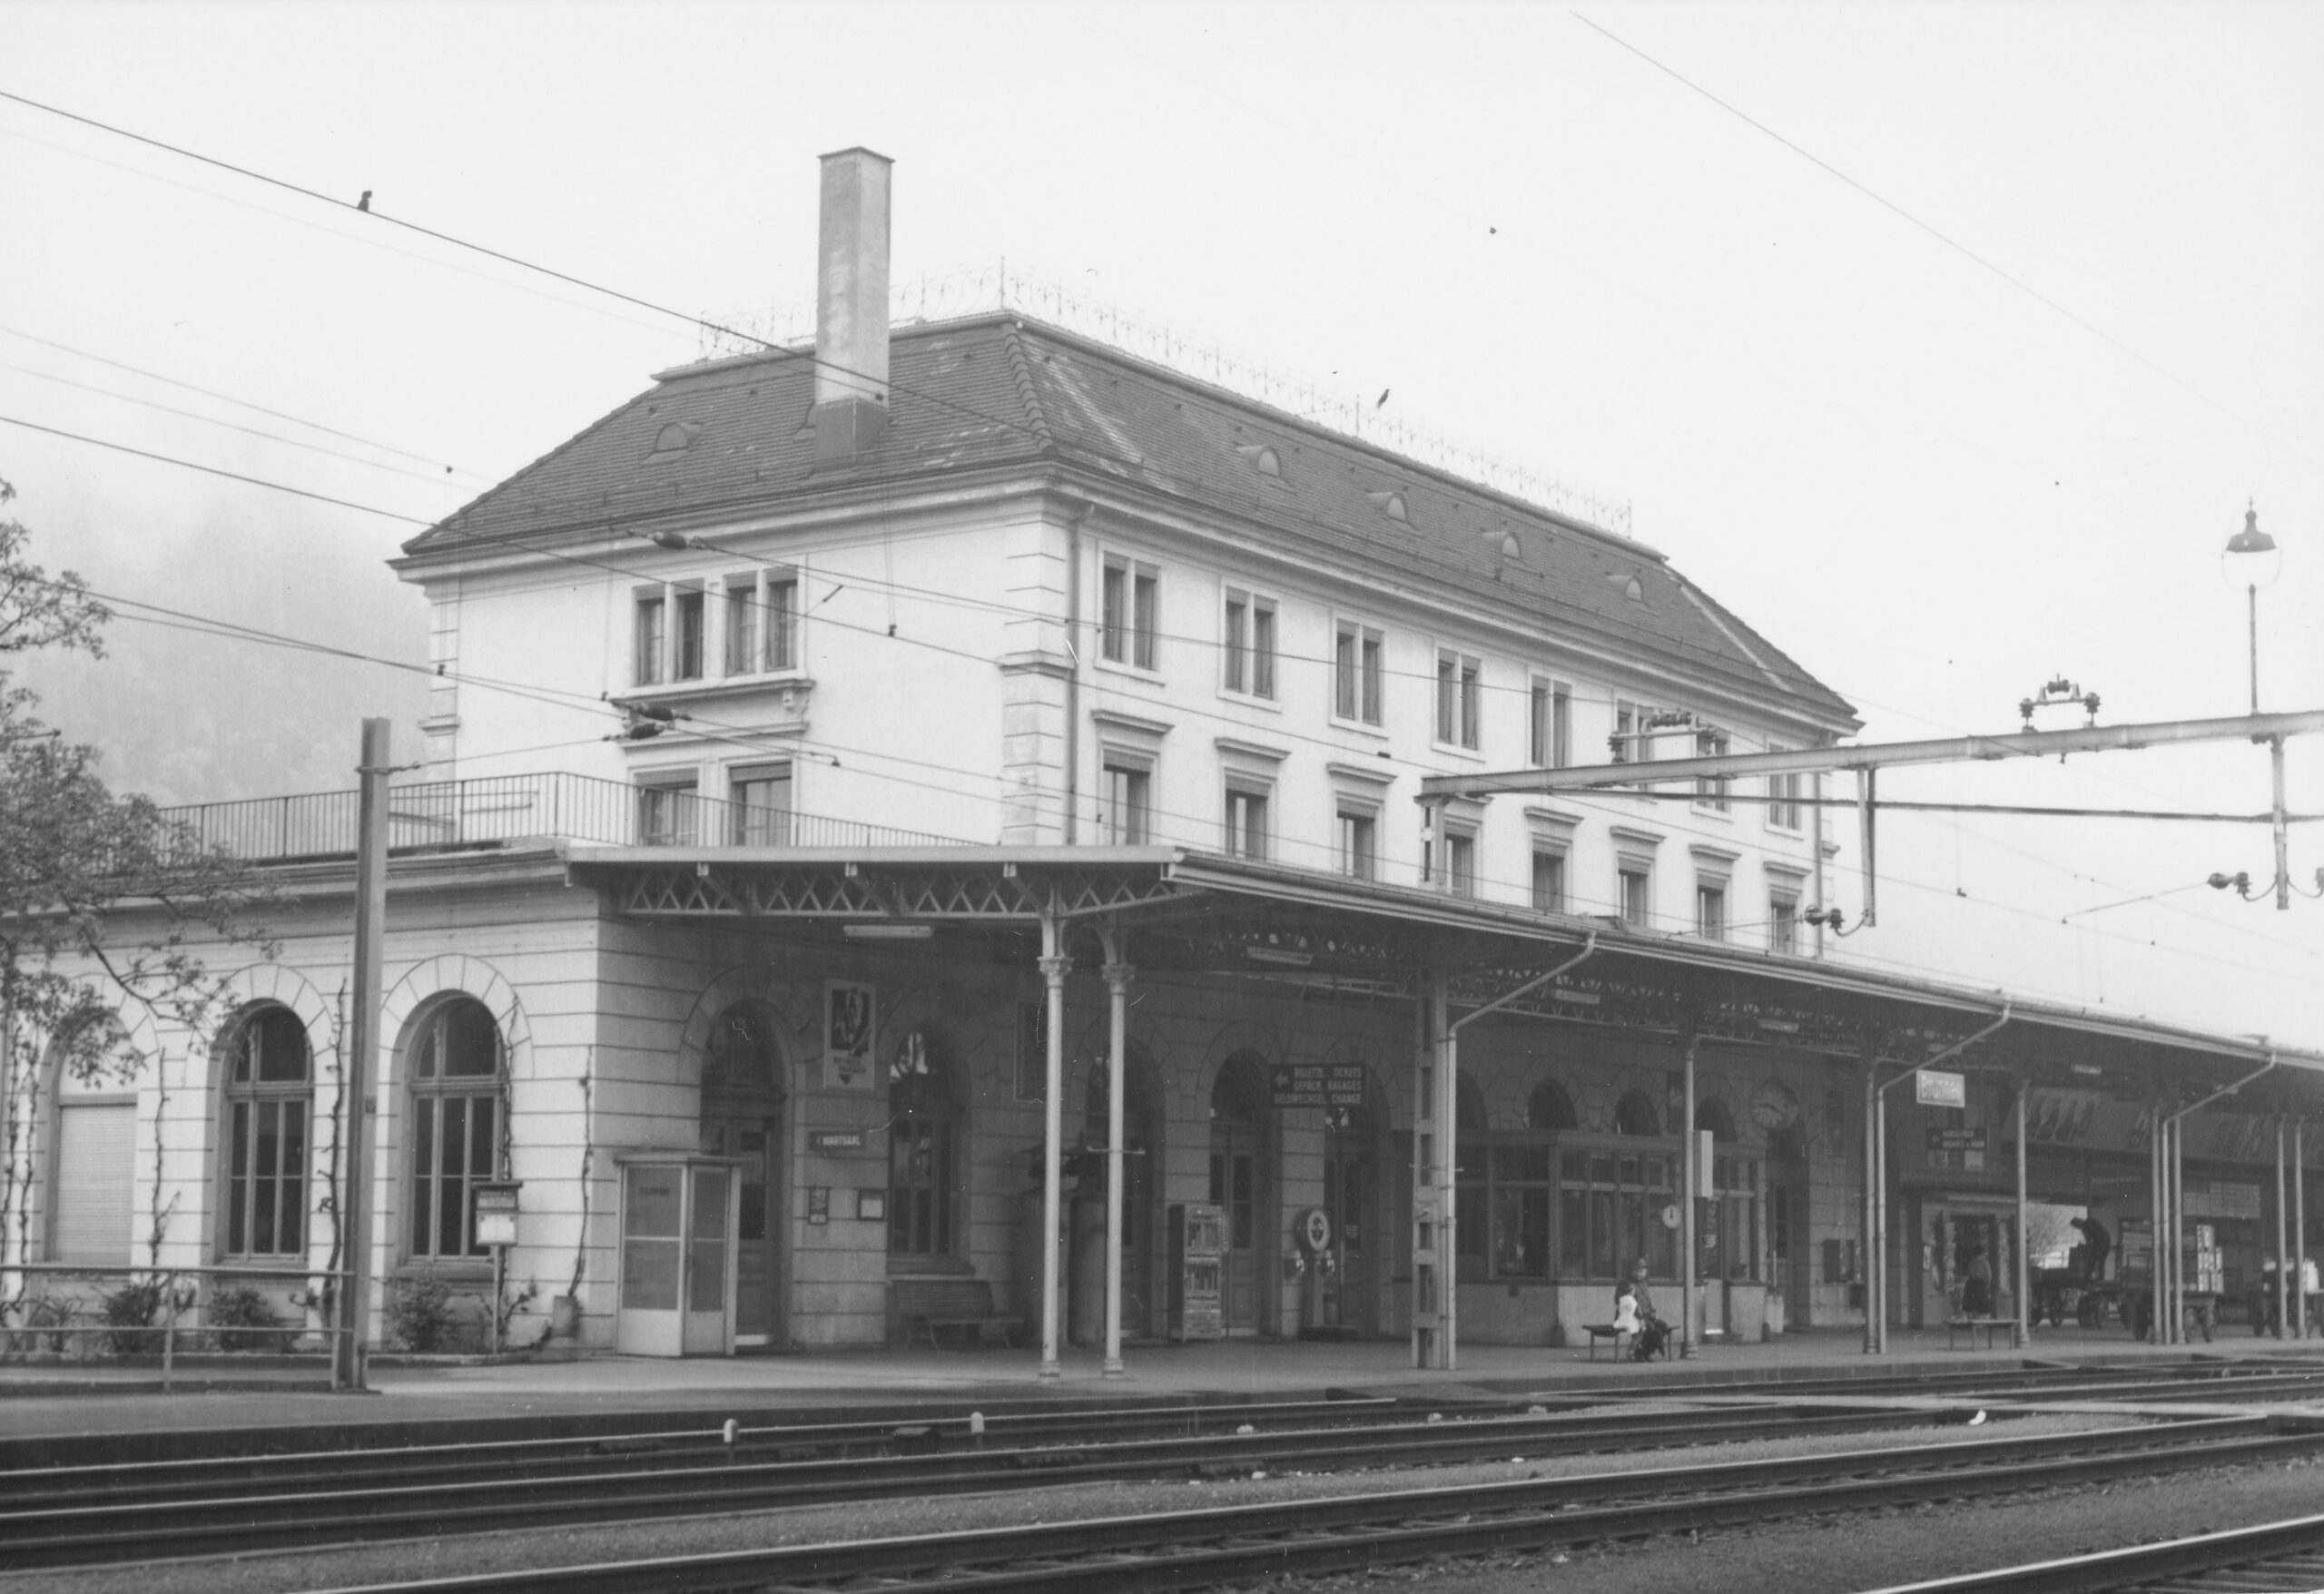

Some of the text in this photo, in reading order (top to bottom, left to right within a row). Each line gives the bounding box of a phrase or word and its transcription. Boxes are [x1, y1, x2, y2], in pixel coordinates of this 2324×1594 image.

[1333, 1068, 1362, 1078] TICKETS
[1327, 1080, 1362, 1091] BAGAGES
[1274, 1093, 1362, 1105] GELDWECHSEL CHANGE
[822, 1135, 861, 1146] WARTSAAL
